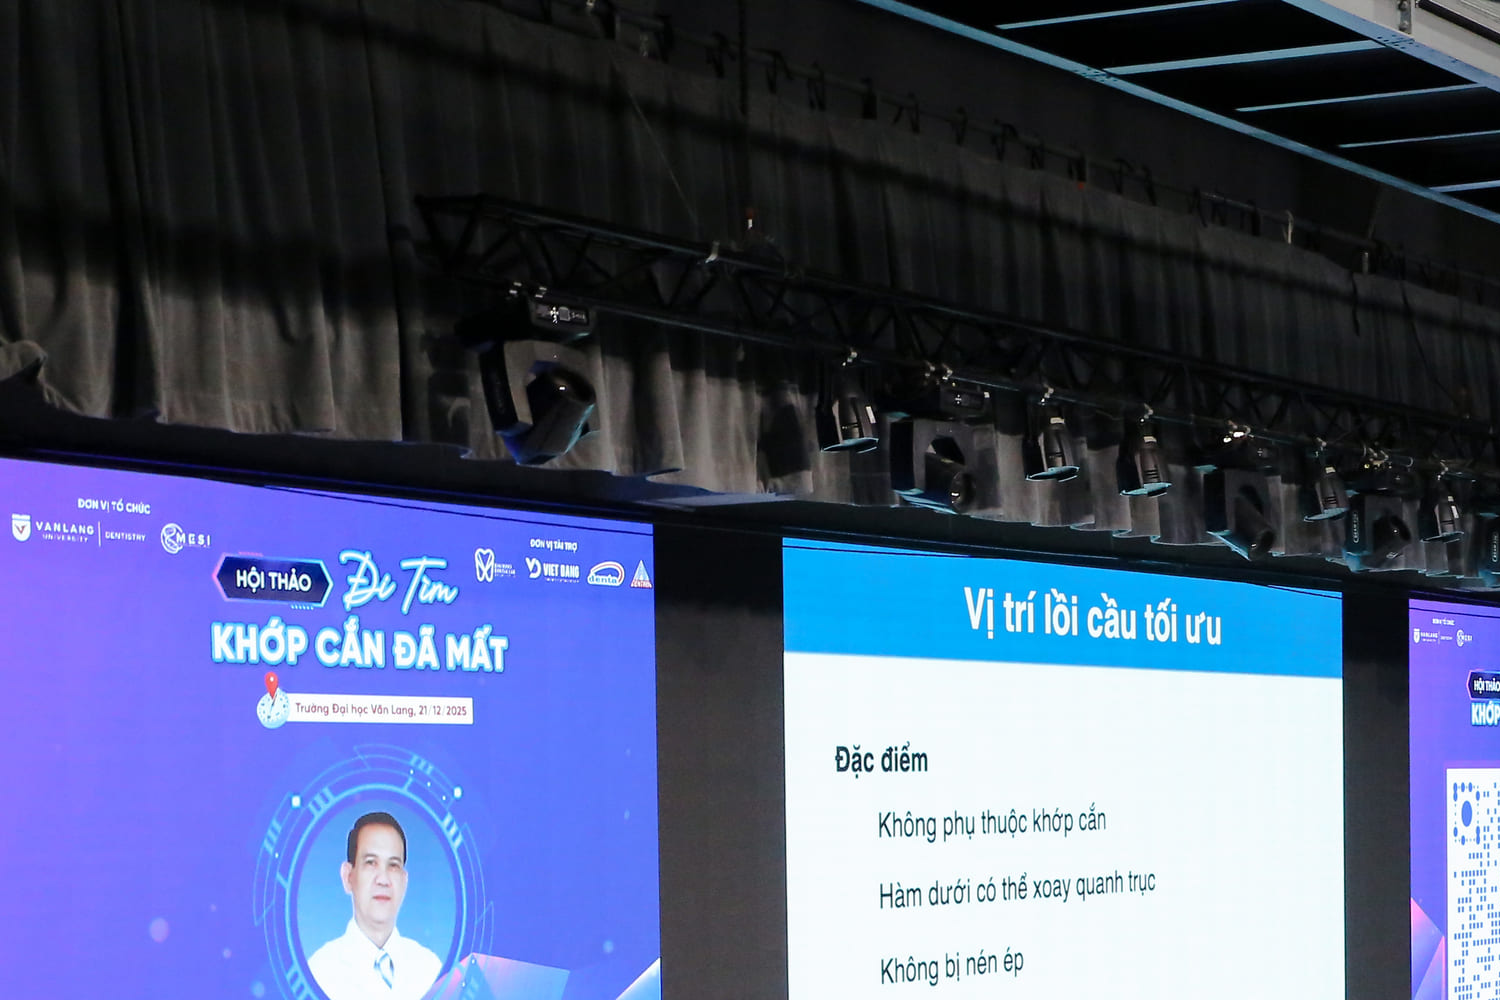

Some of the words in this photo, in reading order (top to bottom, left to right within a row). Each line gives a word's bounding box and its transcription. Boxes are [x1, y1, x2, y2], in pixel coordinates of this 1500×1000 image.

[235, 567, 265, 593] HỘI
[268, 568, 312, 593] THẢO
[964, 587, 994, 640] Vị
[1003, 590, 1037, 634] trí
[1044, 588, 1078, 637] lồi
[1087, 592, 1137, 640] cầu
[1144, 598, 1178, 643] tối
[1184, 611, 1222, 645] ưu
[211, 617, 308, 665] KHỚP
[392, 624, 441, 671] ĐÃ
[445, 624, 509, 672] MẤT
[1473, 678, 1485, 694] HỘI
[295, 703, 329, 715] Trường
[332, 703, 349, 716] Đại
[351, 703, 368, 717] học
[371, 704, 389, 715] Văn
[835, 744, 875, 779] Đặc
[880, 741, 928, 773] điểm
[878, 811, 937, 843] Không
[943, 809, 975, 842] phụ
[981, 808, 1028, 838] thuộc
[1032, 807, 1073, 837] khớp
[1078, 802, 1106, 831] cắn
[879, 882, 922, 909] Hàm
[928, 878, 971, 906] dưới
[976, 876, 996, 902] có
[1002, 871, 1028, 902] thể
[1032, 878, 1071, 904] xoay
[1076, 869, 1124, 901] quanh
[1128, 869, 1156, 896] trục
[880, 956, 939, 986] Không
[945, 952, 960, 980] bị
[966, 948, 997, 976] nén
[1003, 946, 1024, 977] ép
